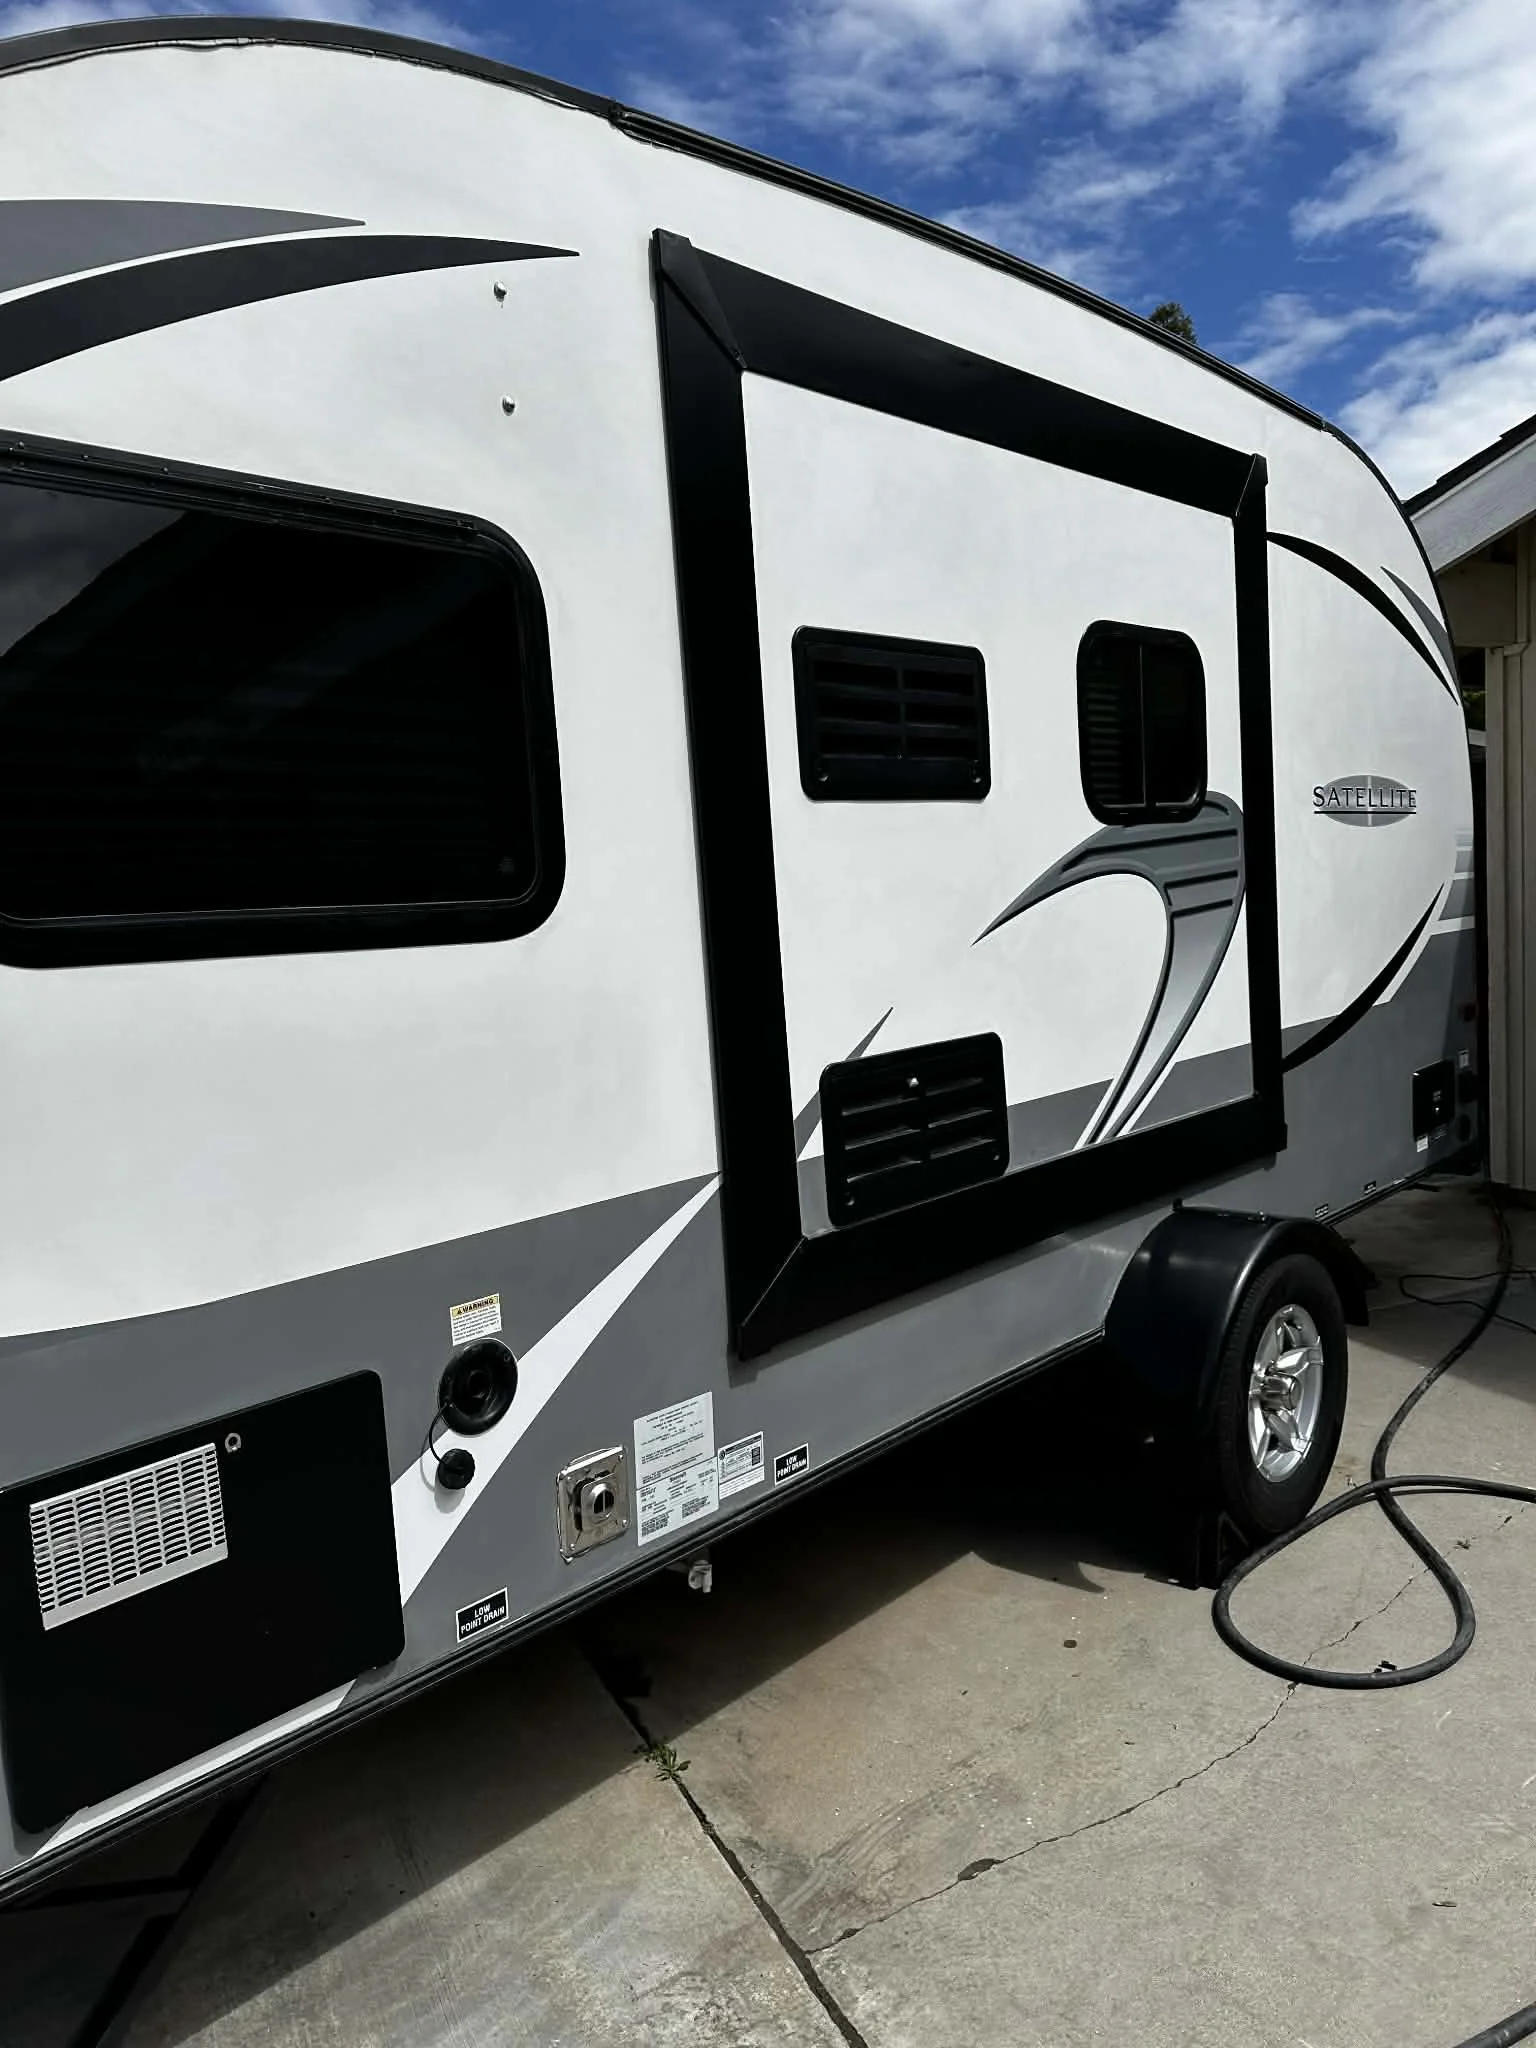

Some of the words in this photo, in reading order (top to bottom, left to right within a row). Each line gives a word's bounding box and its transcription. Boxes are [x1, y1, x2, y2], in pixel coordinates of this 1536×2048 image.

[1313, 786, 1416, 808] SATELLITE
[463, 1299, 494, 1313] WARNING
[786, 1455, 797, 1465] LOW
[474, 1603, 491, 1617] LOW
[461, 1617, 482, 1634] POINT
[483, 1606, 505, 1623] DRAIN
